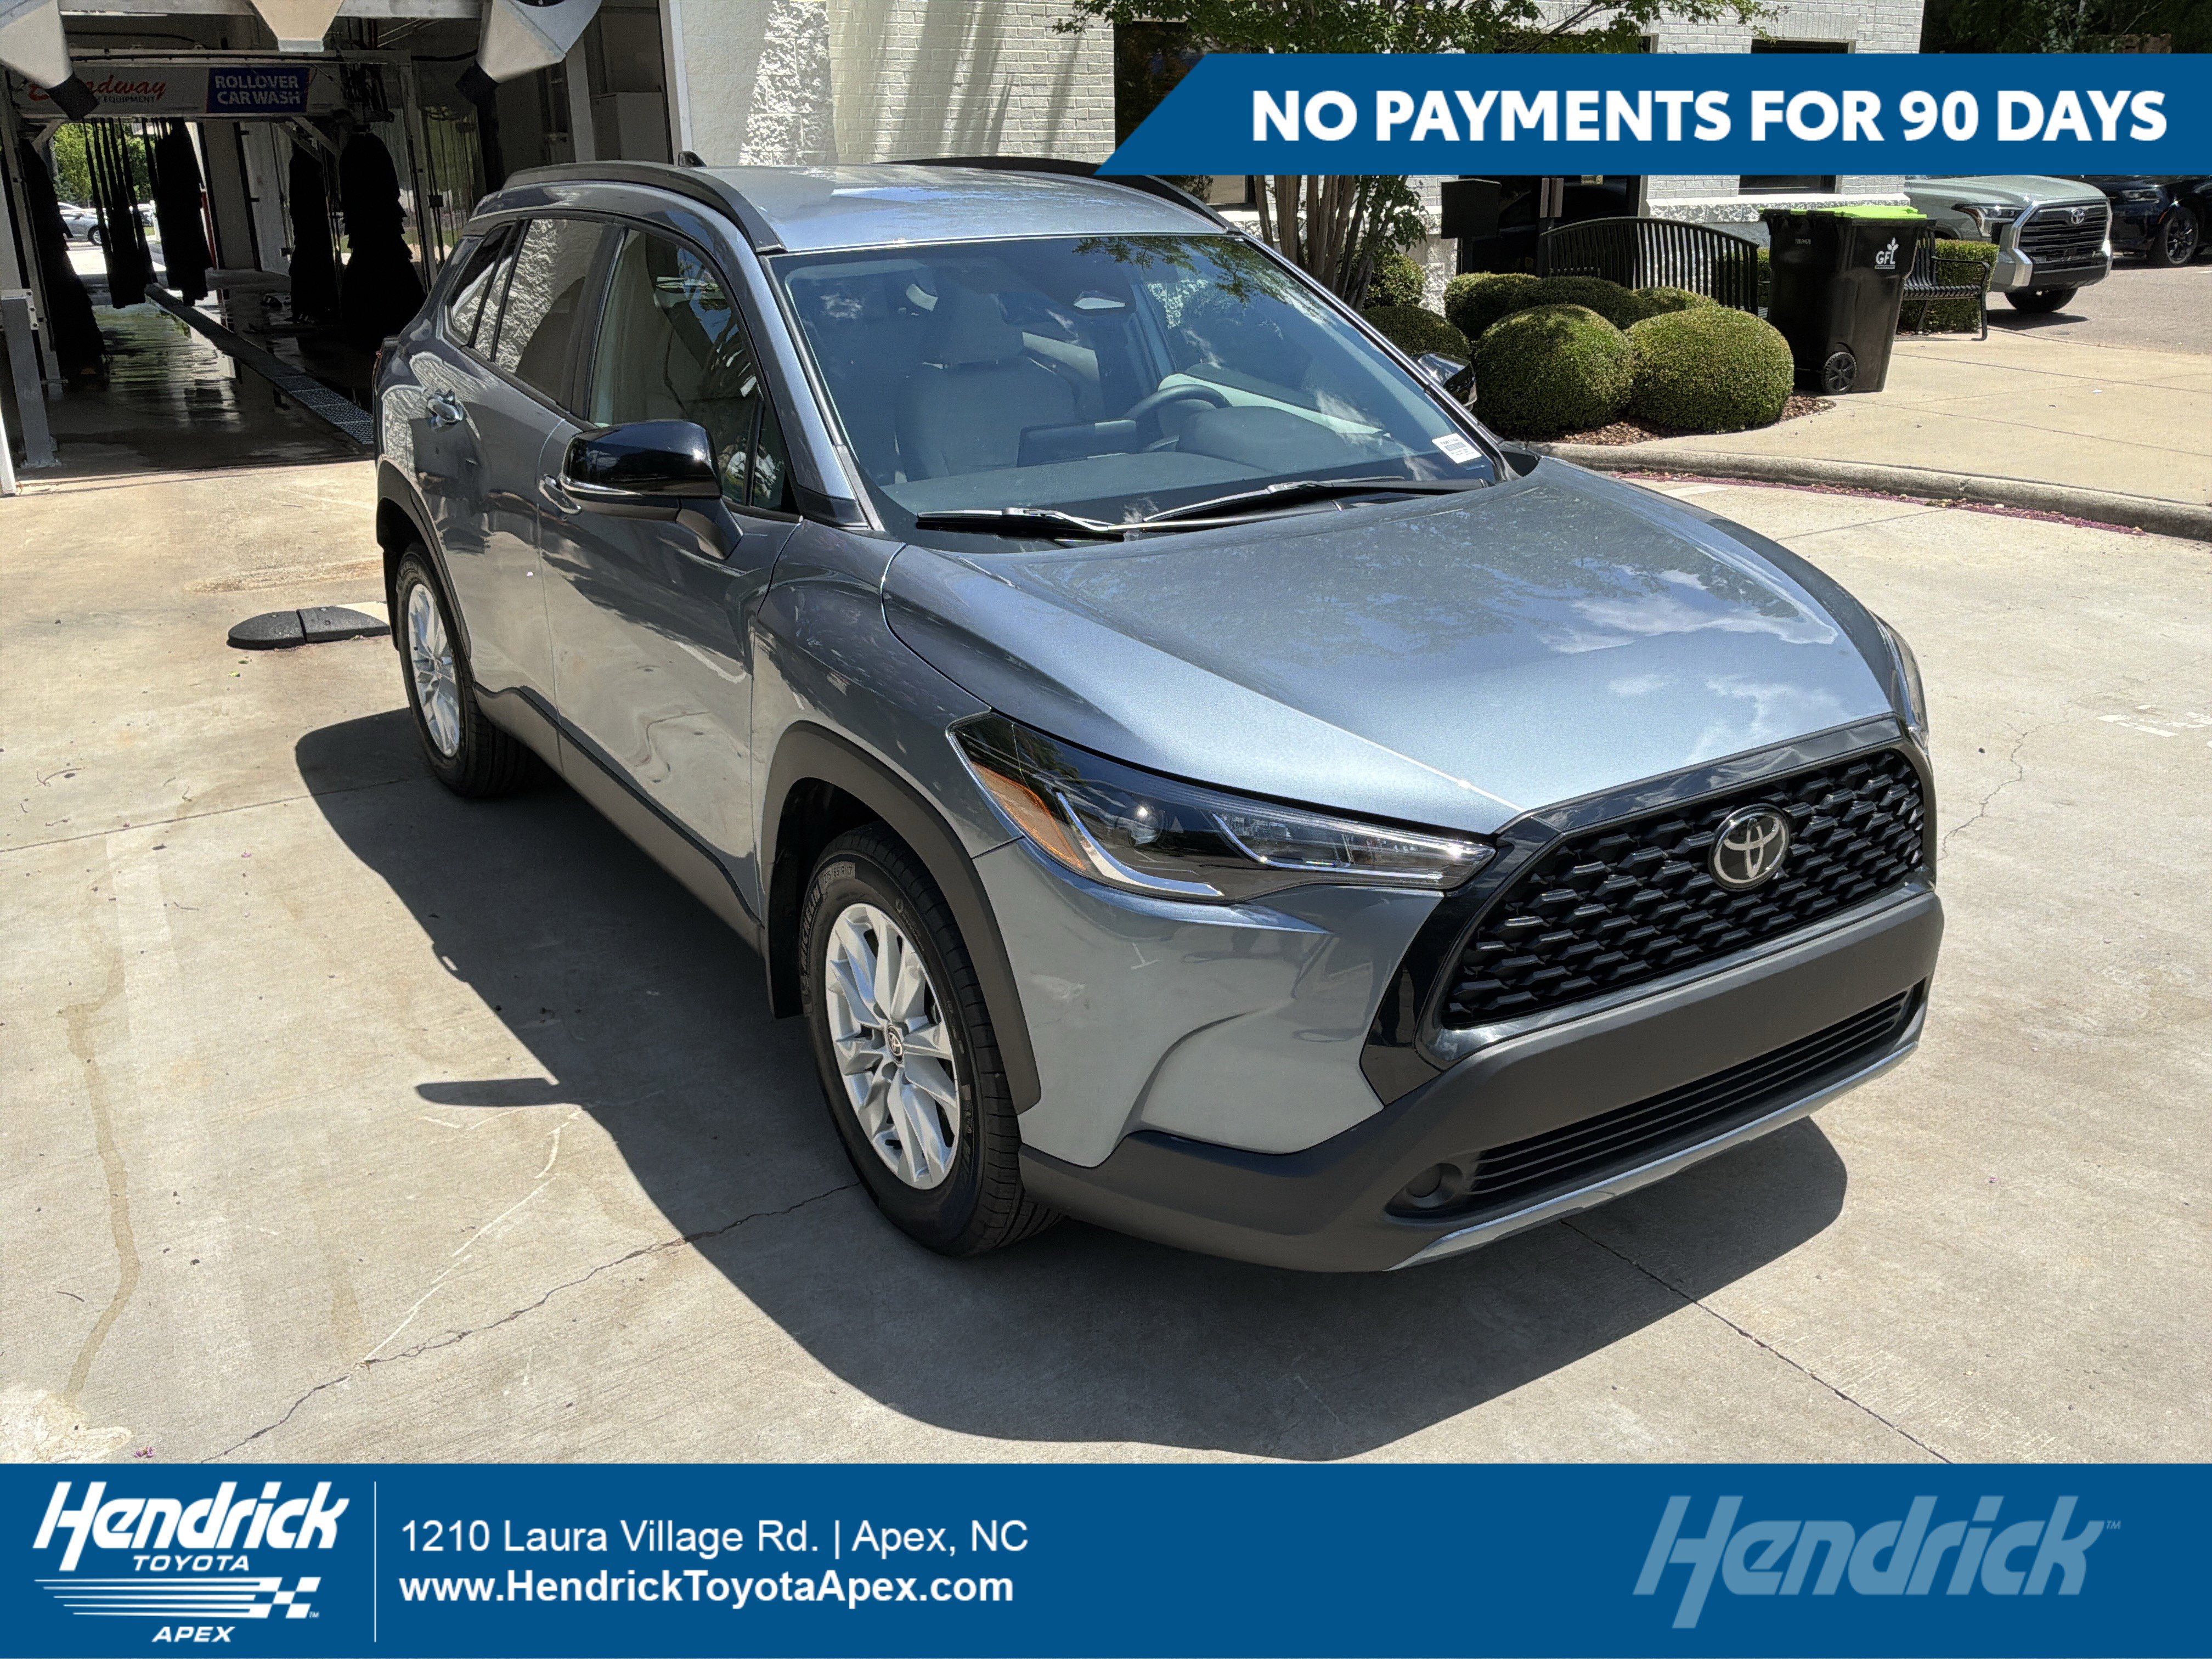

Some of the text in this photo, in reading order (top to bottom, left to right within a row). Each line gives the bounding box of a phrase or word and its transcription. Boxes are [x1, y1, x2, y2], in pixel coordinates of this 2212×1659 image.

[215, 75, 300, 89] ROLLOVER
[104, 95, 155, 104] EQUIPMENT
[217, 91, 301, 105] CAR WASH
[1876, 245, 1898, 264] GFL
